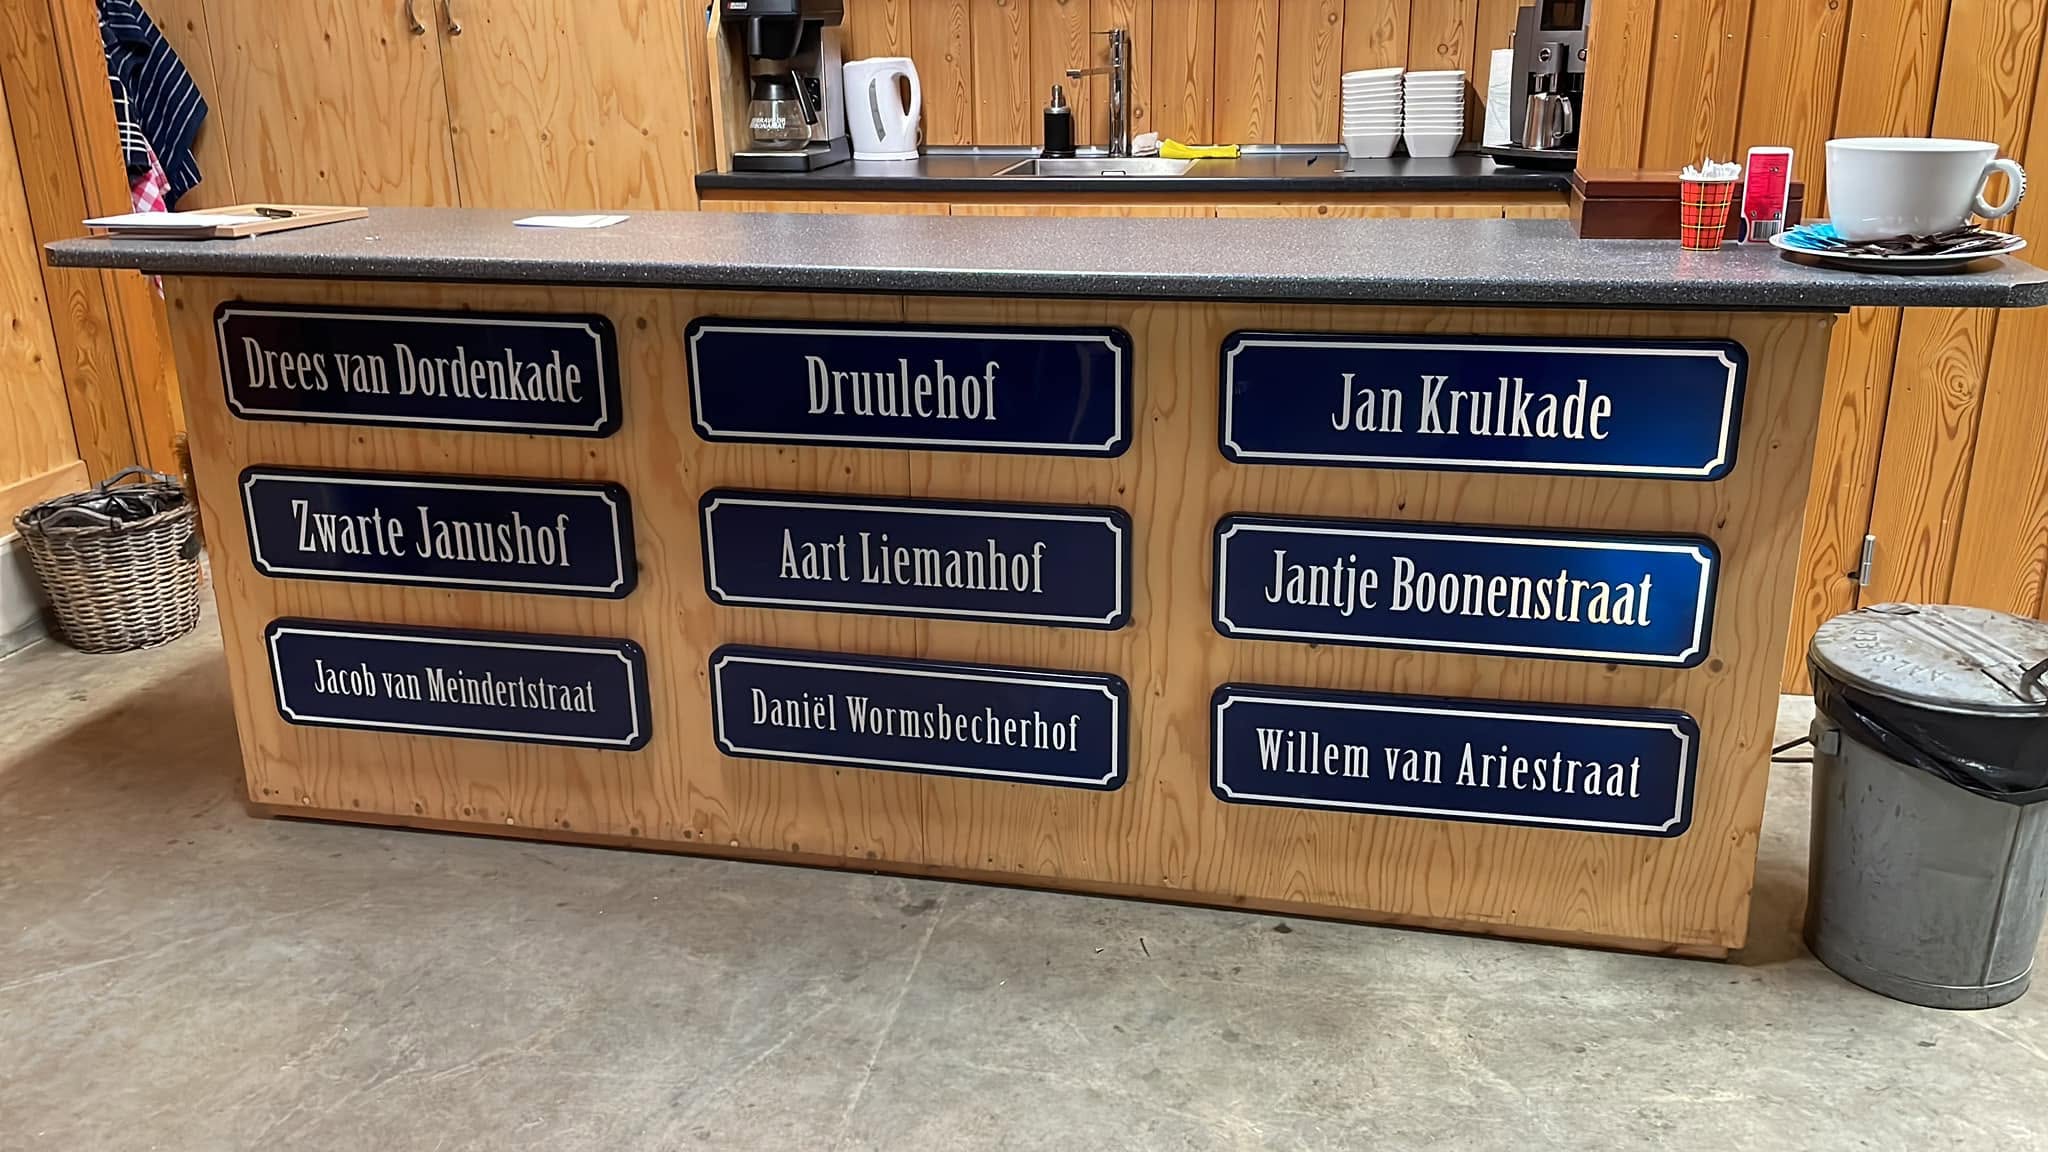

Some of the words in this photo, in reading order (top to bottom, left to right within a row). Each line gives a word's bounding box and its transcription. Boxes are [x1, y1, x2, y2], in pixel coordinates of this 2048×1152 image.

[241, 337, 328, 391] Drees
[334, 353, 389, 394] van
[393, 343, 583, 403] Dordenkade
[805, 355, 1000, 421] Druulehof
[1331, 373, 1403, 433] Jan
[1416, 375, 1612, 440] Krulkade
[291, 499, 406, 557] Zwarte
[415, 506, 570, 567] Janushof
[779, 528, 850, 582] Aart
[859, 532, 1047, 593] Liemanhof
[1264, 549, 1378, 617] Jantje
[1389, 556, 1653, 627] Boonenstraat
[314, 659, 377, 698] Jacob
[381, 672, 422, 701] van
[425, 667, 597, 713] Meindertstraat
[751, 688, 837, 731] Daniël
[845, 695, 1081, 752] Wormsbecherhof
[1255, 727, 1370, 778] Willem
[1384, 747, 1442, 784] van
[1455, 742, 1642, 798] Ariestraat
